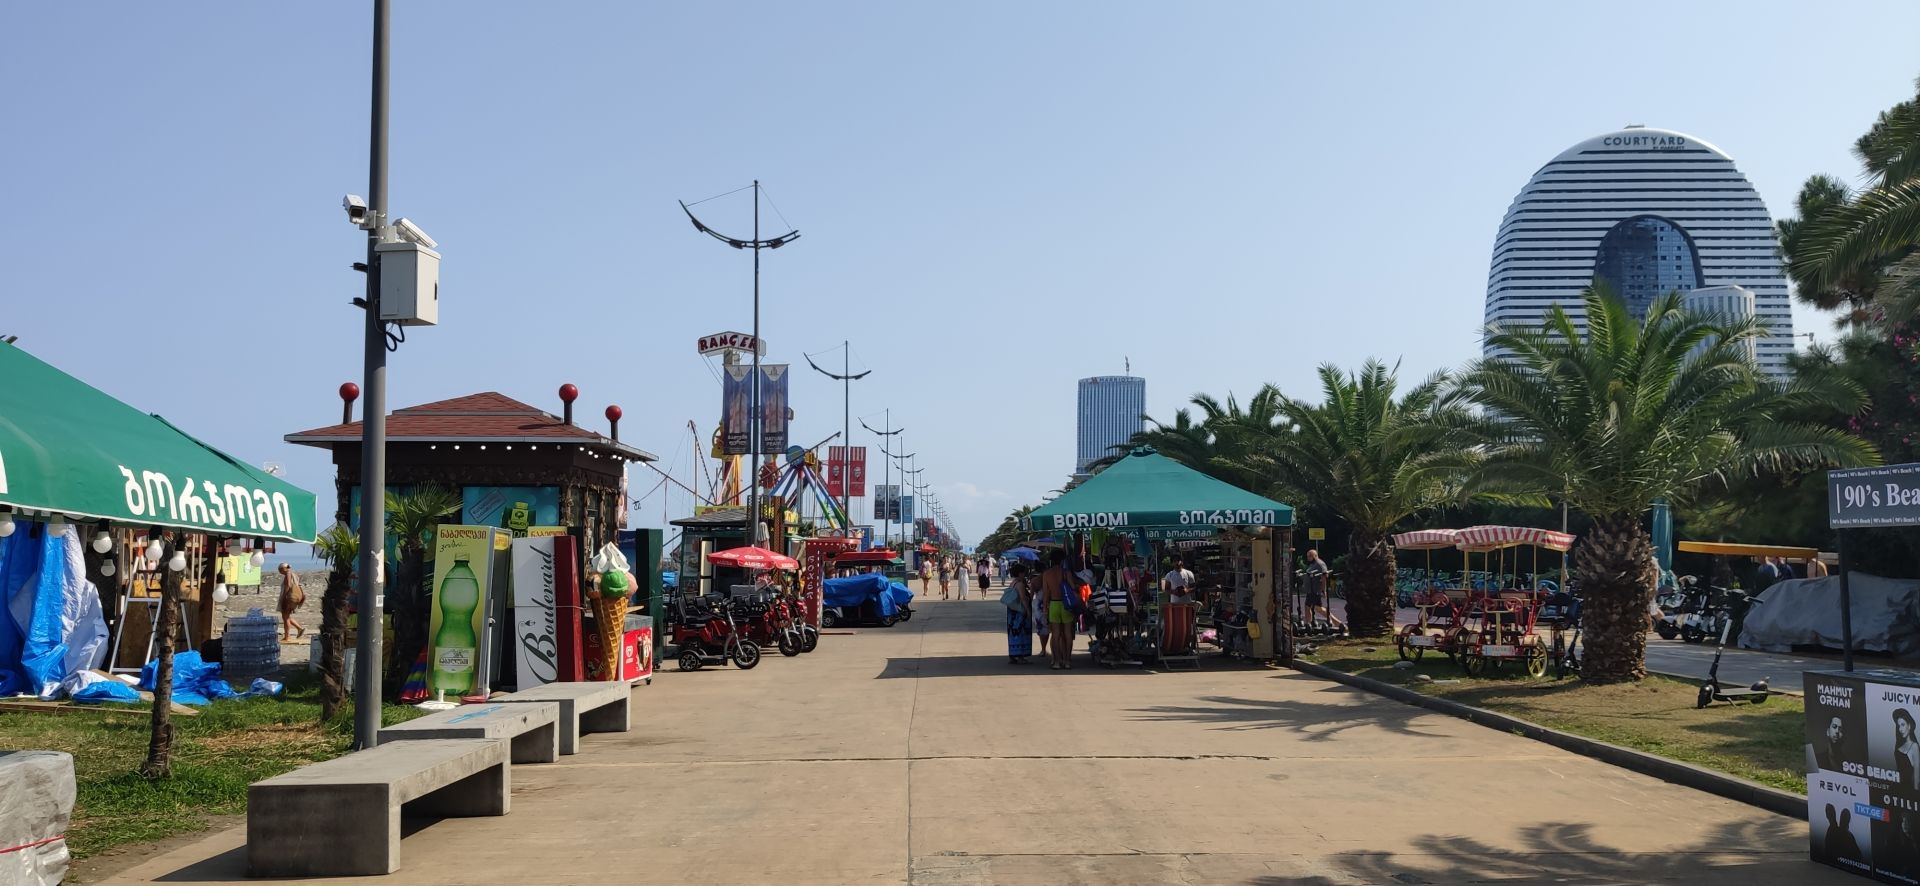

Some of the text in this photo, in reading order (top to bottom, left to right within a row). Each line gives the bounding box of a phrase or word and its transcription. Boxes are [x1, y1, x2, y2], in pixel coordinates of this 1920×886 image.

[1603, 136, 1686, 146] COURTYARD
[699, 335, 758, 351] RANGER
[118, 464, 293, 534] ბორჯომი
[1844, 484, 1881, 508] 90's
[1053, 512, 1128, 529] BORJOMI
[1179, 510, 1275, 524] ბორჯომი
[440, 529, 487, 540] ნაბეღლავი
[1166, 530, 1212, 538] ბორჯომი
[518, 545, 558, 684] Boulevard
[1817, 684, 1853, 698] MAHMUT
[1882, 691, 1910, 704] JUICY
[1819, 695, 1851, 709] ORHAN
[1842, 761, 1900, 783] 90'S BEACH
[1820, 780, 1857, 796] REVOL
[1883, 794, 1918, 812] OTILI
[1856, 805, 1881, 818] TKT.GE
